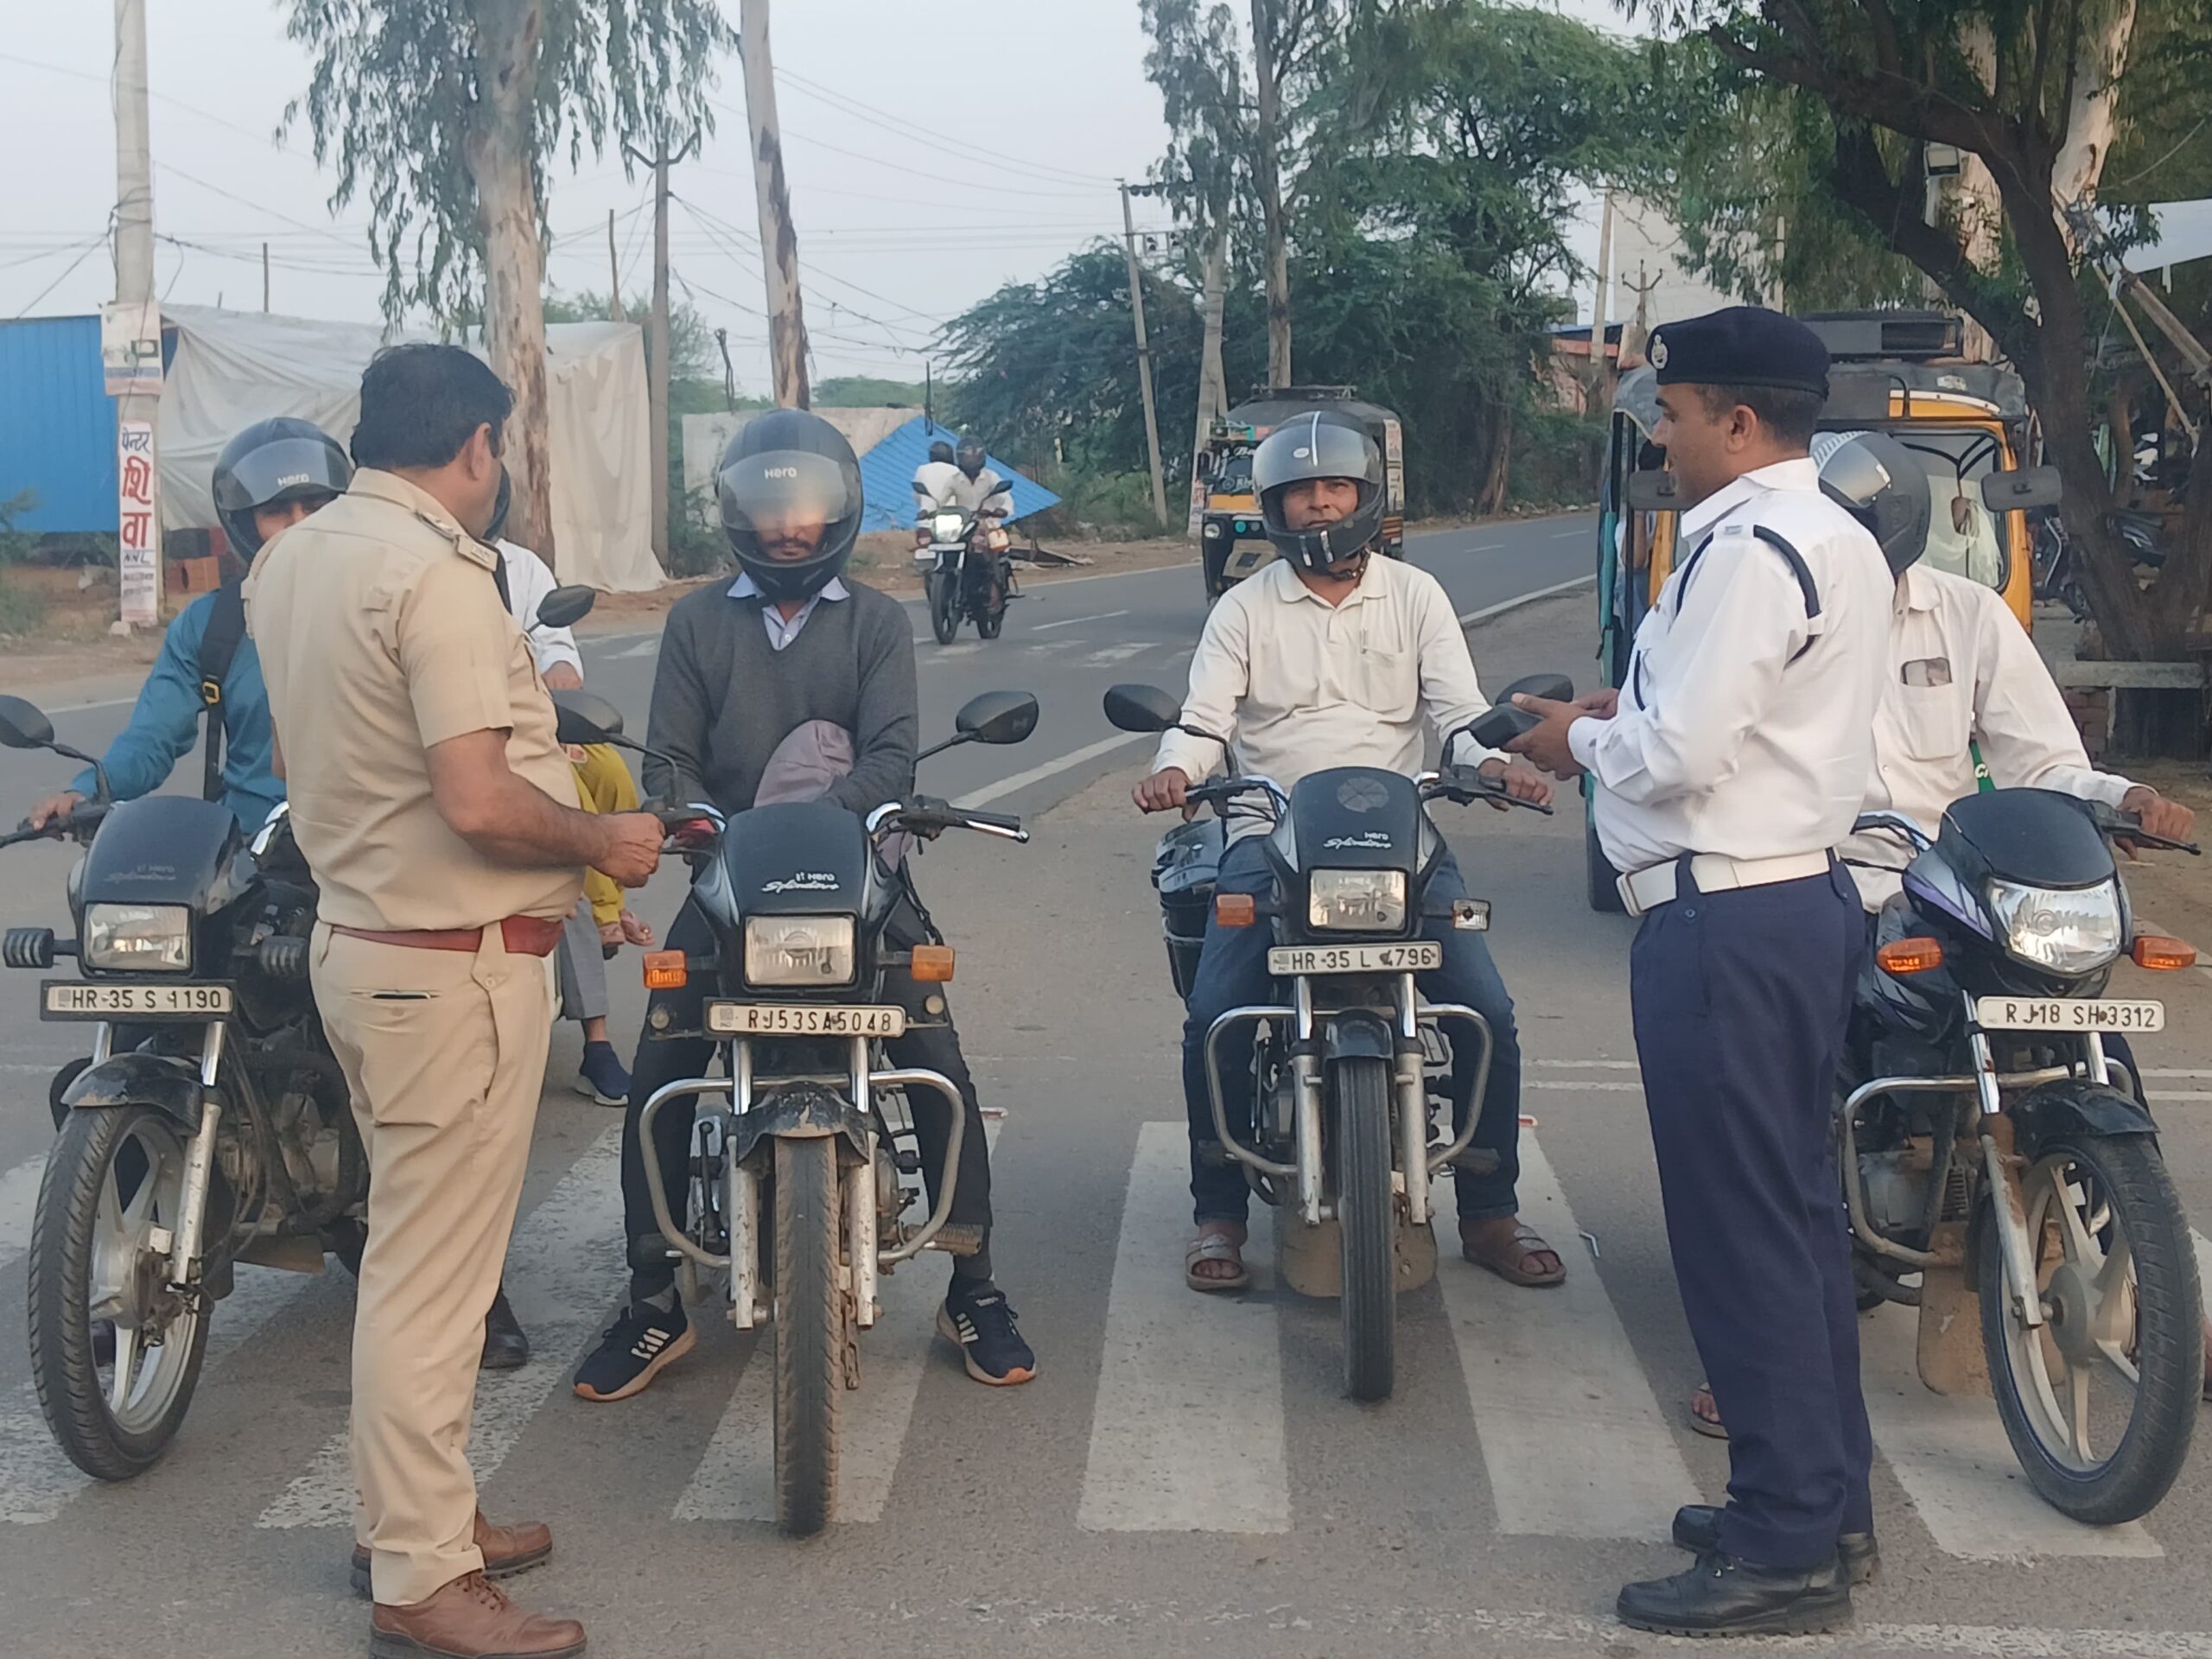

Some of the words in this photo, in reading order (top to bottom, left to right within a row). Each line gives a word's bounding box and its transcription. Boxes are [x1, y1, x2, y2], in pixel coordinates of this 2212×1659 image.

[1293, 952, 1315, 969] HR
[1326, 950, 1350, 969] 35
[1360, 951, 1371, 968] L
[73, 989, 98, 1008] HR
[109, 989, 133, 1008] 35
[144, 990, 156, 1008] S
